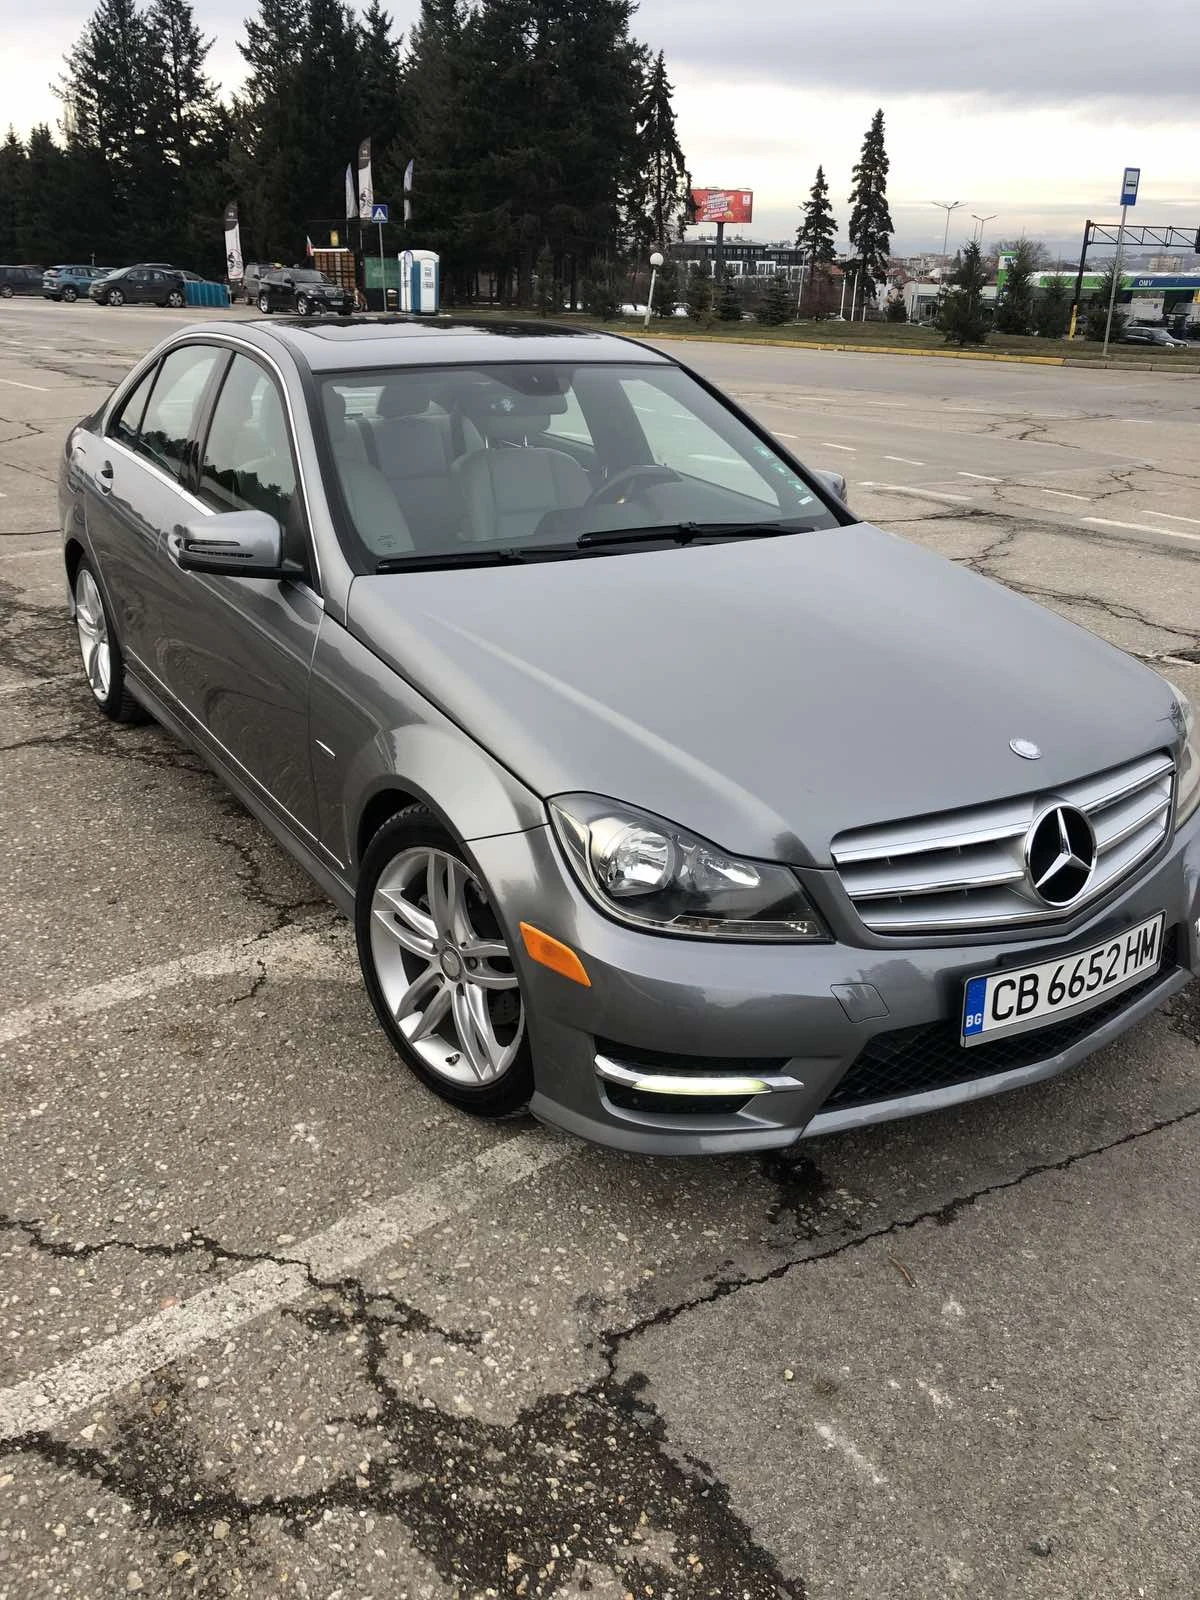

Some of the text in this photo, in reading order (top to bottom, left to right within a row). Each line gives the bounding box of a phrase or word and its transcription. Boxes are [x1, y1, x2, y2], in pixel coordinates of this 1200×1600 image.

[1138, 279, 1153, 287] OMV
[992, 922, 1158, 1021] CB 6652 HM
[966, 1015, 982, 1026] BG
